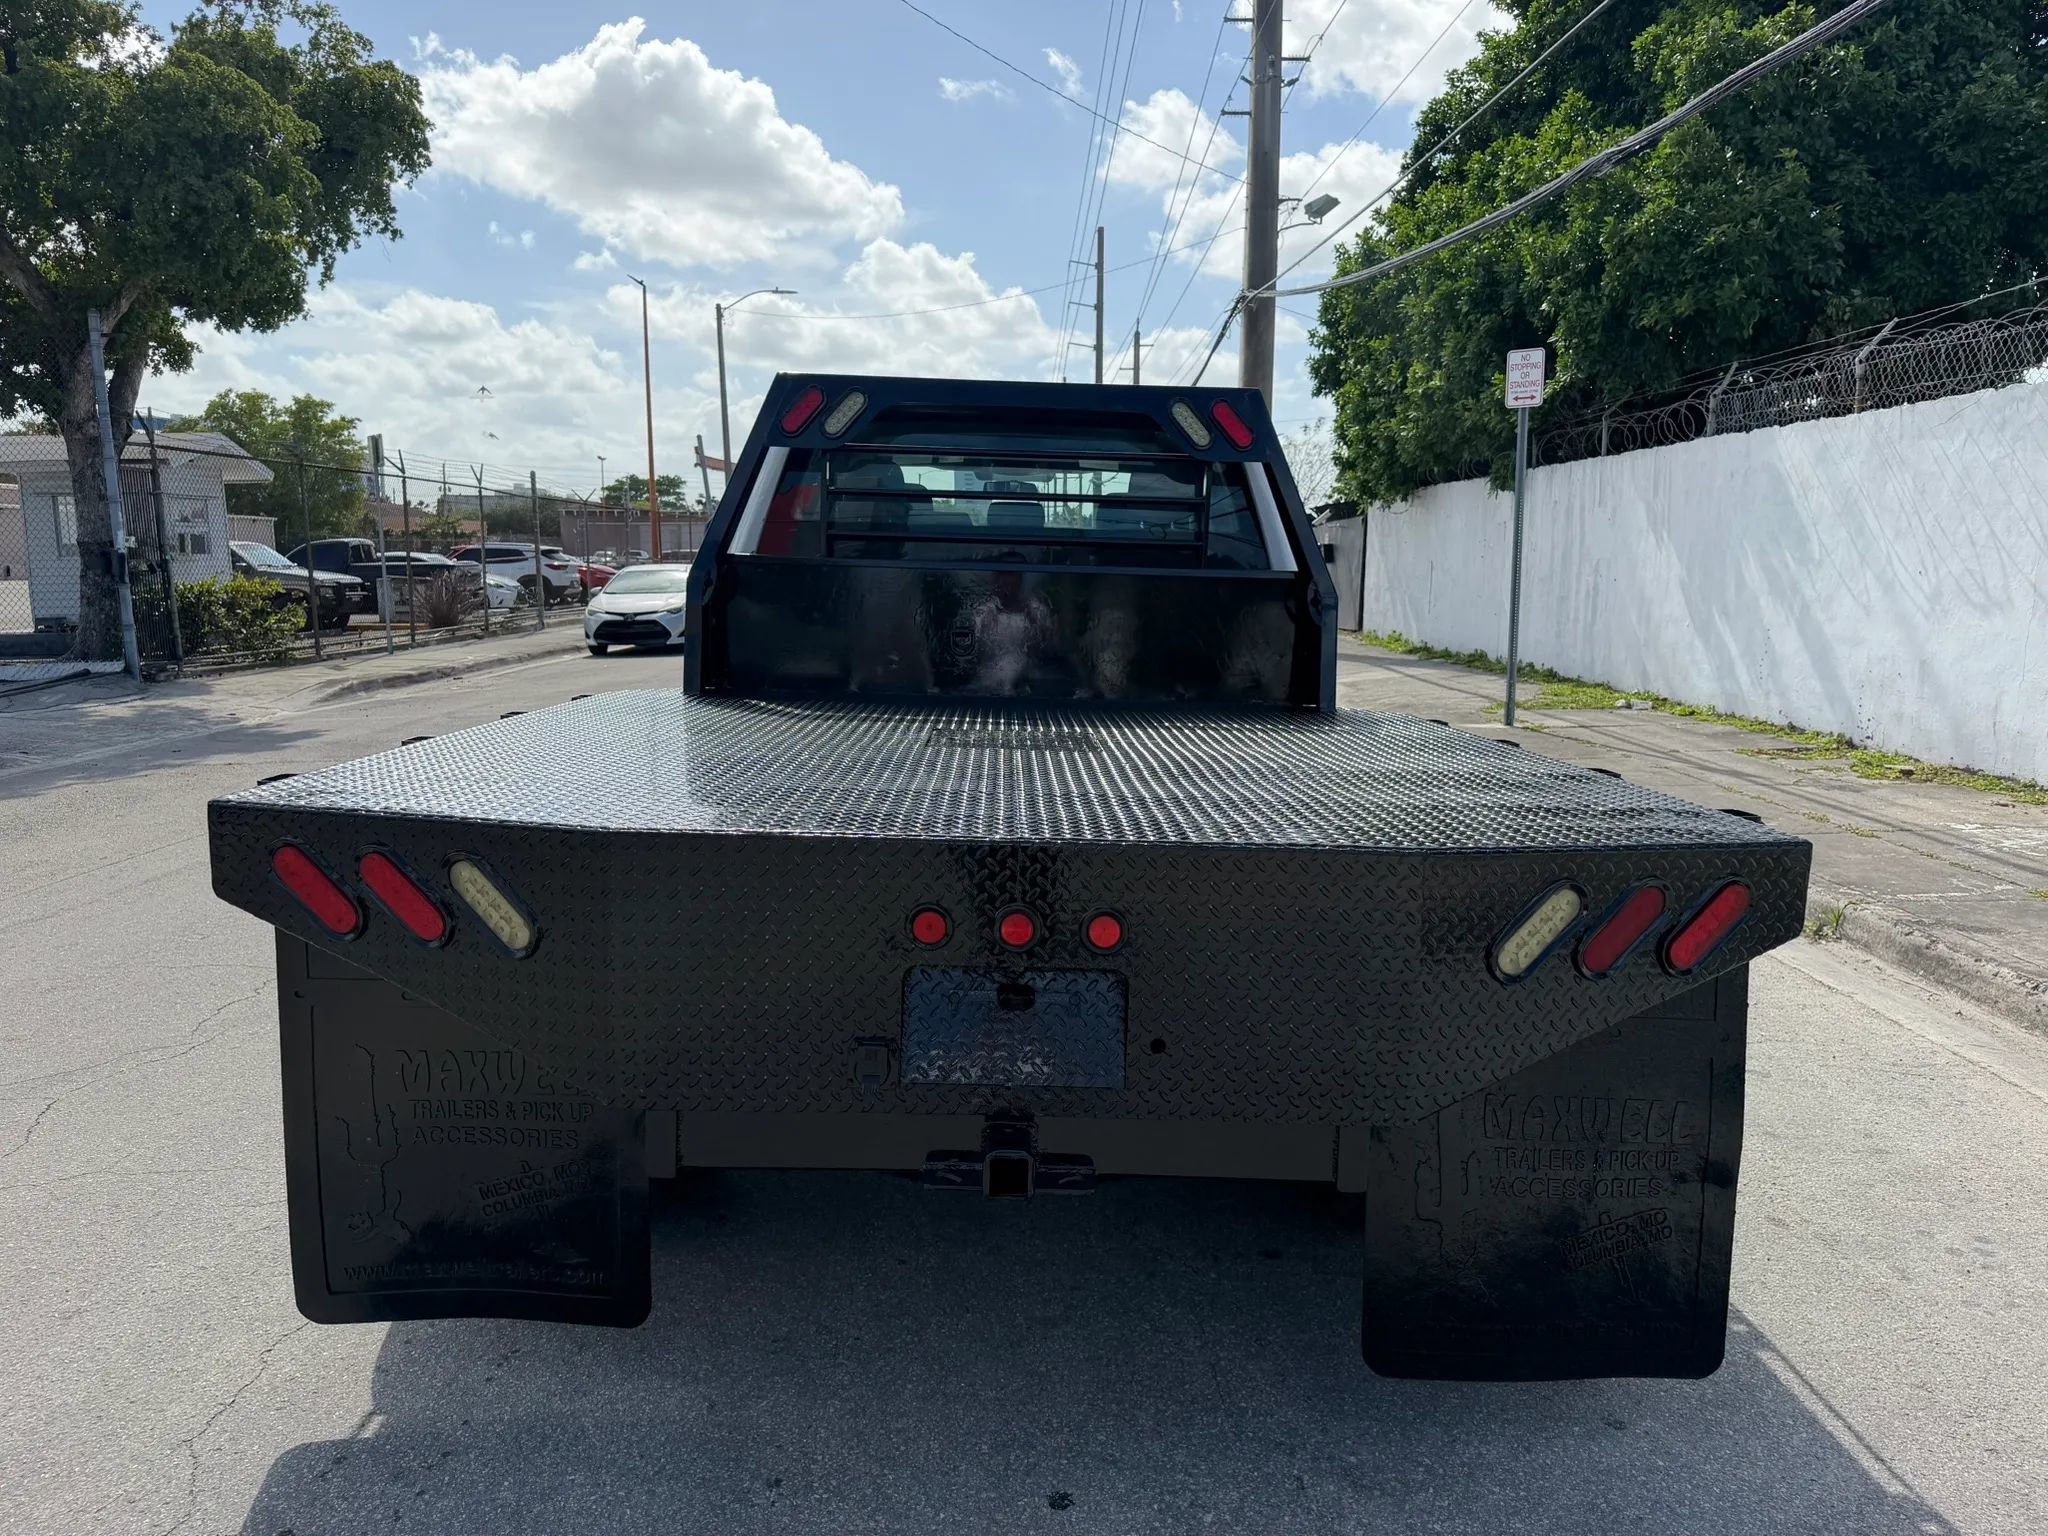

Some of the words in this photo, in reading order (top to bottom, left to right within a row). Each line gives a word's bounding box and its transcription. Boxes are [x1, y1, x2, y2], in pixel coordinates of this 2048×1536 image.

[1510, 361, 1541, 372] STOPPING
[1520, 371, 1530, 379] OR
[1510, 380, 1540, 389] STANDING
[408, 1099, 499, 1120] TRAILERS
[505, 1101, 517, 1121] &
[521, 1102, 564, 1122] PICK
[570, 1102, 594, 1122] UP
[1483, 1092, 1696, 1144] MAXWELL
[412, 1126, 579, 1149] ACCESSORIES
[1494, 1146, 1586, 1171] TRAILERS
[1609, 1150, 1651, 1171] PICK
[1655, 1151, 1680, 1171] UP
[1493, 1175, 1664, 1199] ACCESSORIES
